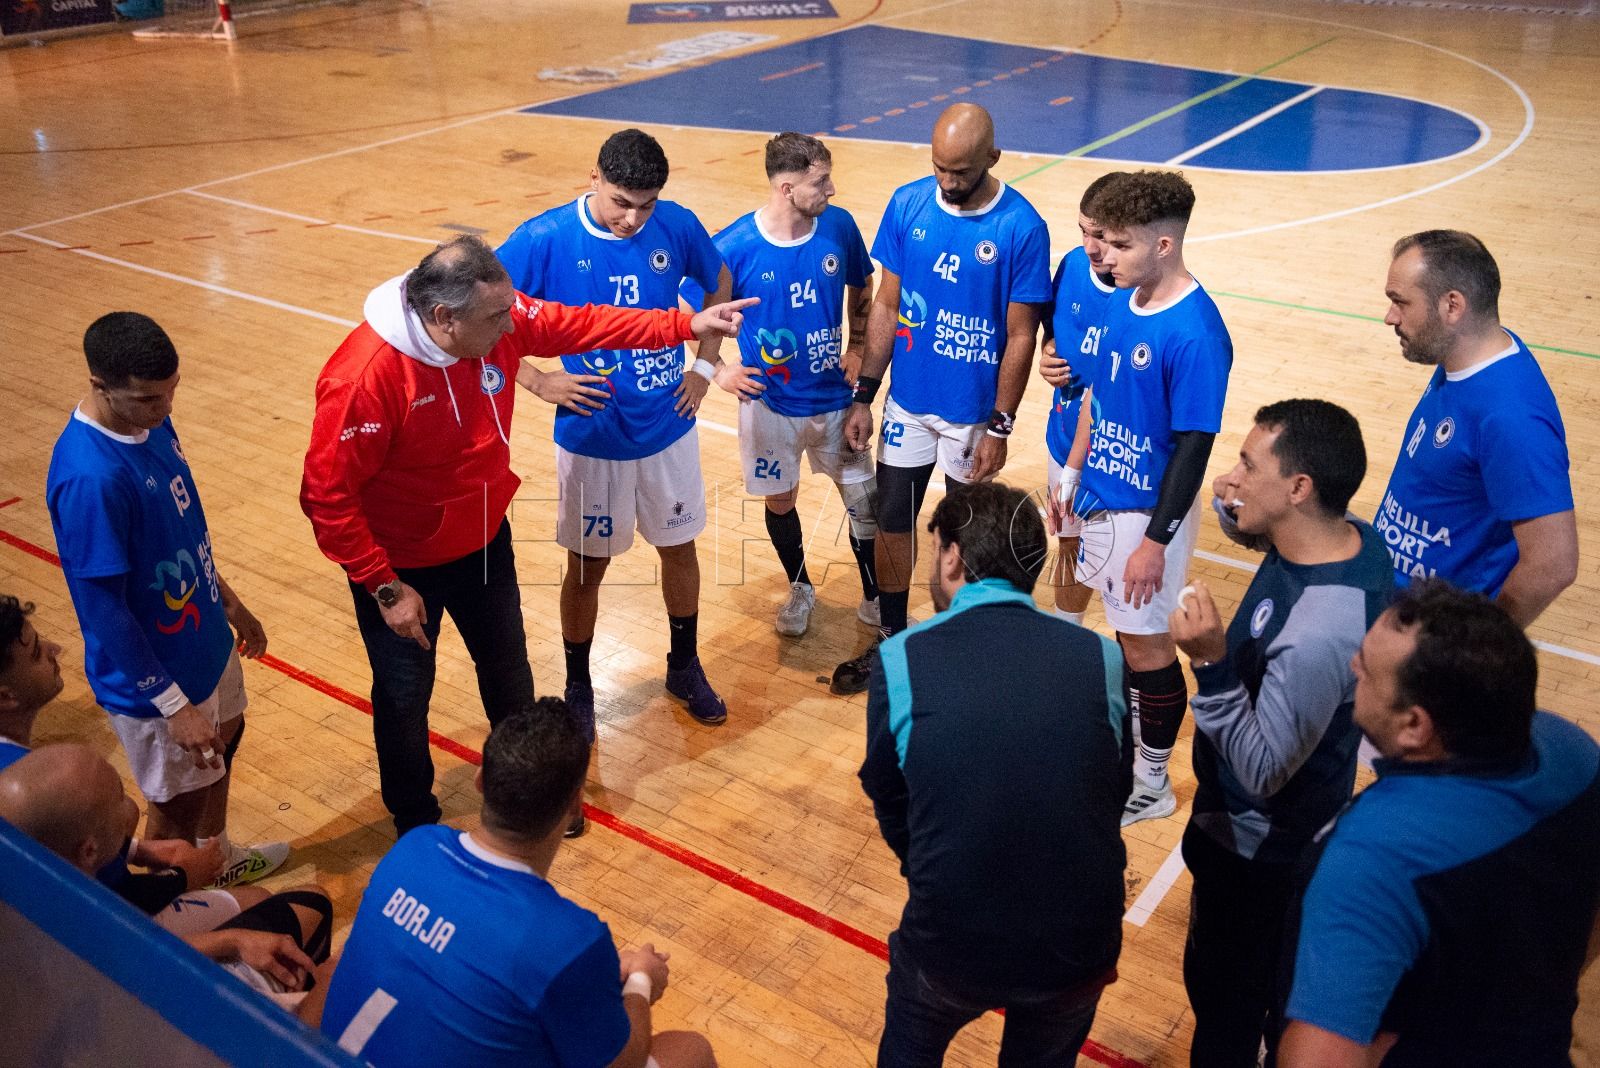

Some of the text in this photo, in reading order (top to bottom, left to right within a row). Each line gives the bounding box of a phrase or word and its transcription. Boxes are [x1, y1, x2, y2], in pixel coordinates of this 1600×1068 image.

[932, 252, 961, 283] 42
[608, 274, 640, 306] 73
[789, 279, 817, 309] 24
[934, 324, 990, 348] SPORT
[633, 349, 677, 375] SPORT
[932, 340, 999, 365] CAPITAL
[881, 420, 905, 447] 42
[1098, 418, 1153, 453] MELILLA
[1406, 417, 1427, 459] 18
[1091, 435, 1141, 469] SPORT
[754, 457, 782, 480] 24
[1087, 451, 1153, 491] CAPITAL
[169, 474, 191, 518] 19
[583, 515, 613, 538] 73
[1383, 490, 1451, 547] MELILLA
[1376, 510, 1430, 560] SPORT
[382, 887, 457, 954] BORJA
